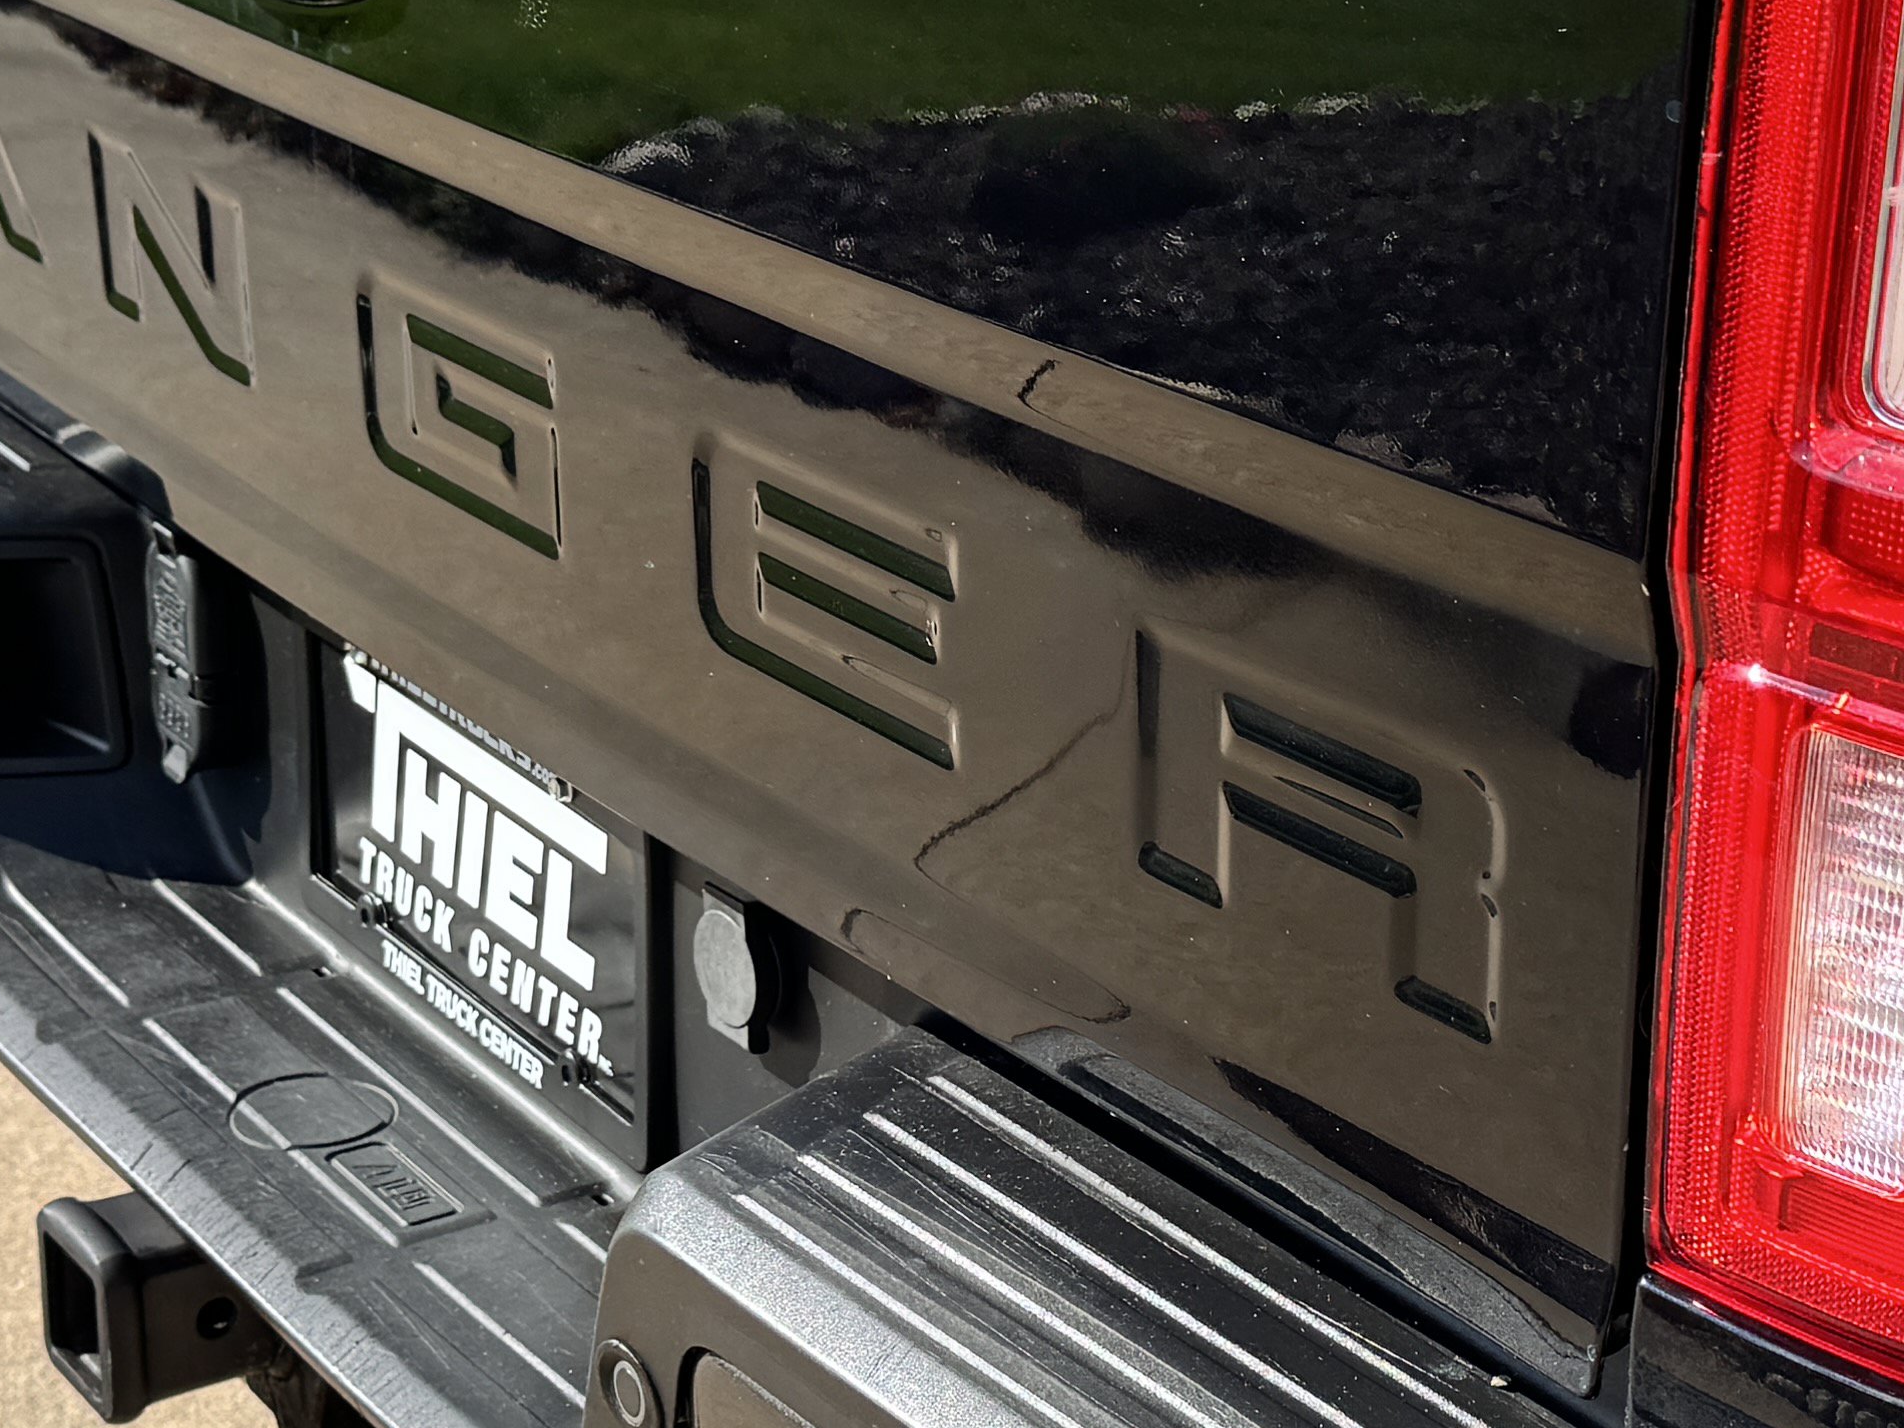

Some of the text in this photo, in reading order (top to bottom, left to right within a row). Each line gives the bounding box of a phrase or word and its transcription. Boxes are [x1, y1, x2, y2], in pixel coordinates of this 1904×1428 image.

[344, 654, 608, 991] THIEL
[359, 837, 602, 1062] TRUCK CENTER
[381, 939, 425, 995] THIEL
[426, 979, 478, 1037] TRUCK
[479, 1017, 544, 1089] CENTER
